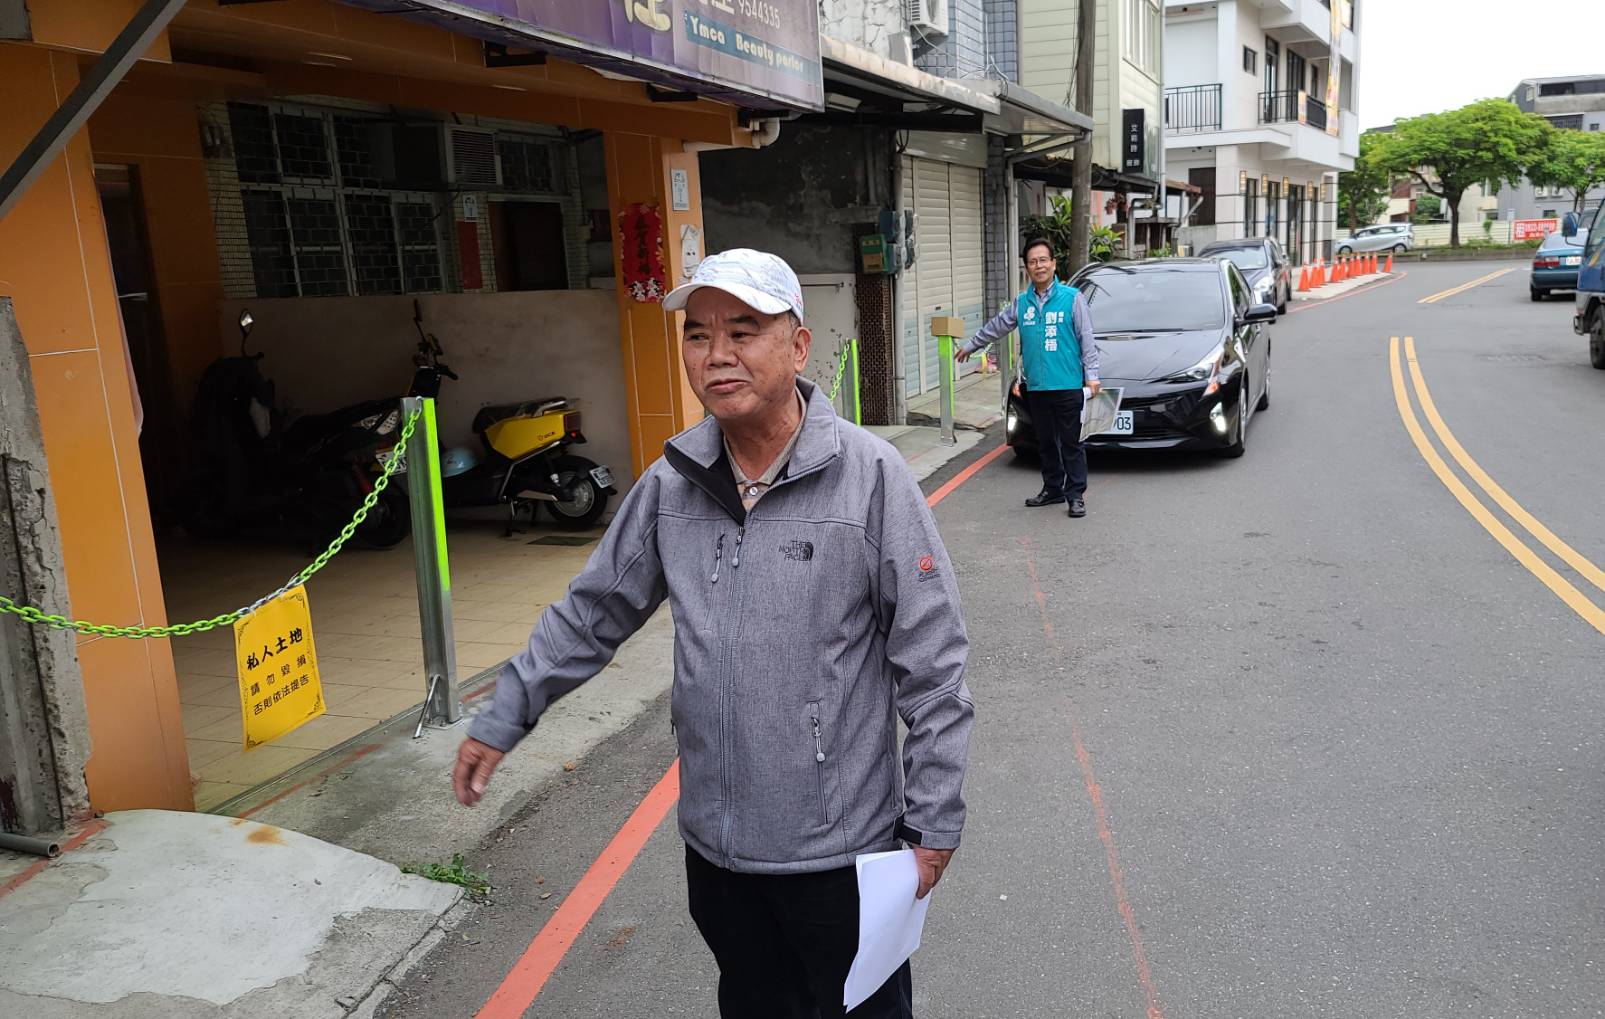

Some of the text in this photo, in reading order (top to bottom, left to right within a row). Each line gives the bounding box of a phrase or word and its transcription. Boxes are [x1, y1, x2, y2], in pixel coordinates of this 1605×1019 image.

[690, 14, 725, 45] Ymca
[736, 33, 774, 67] Beauty
[246, 627, 303, 671] 私人土地
[250, 654, 307, 697] 請勿毀損
[253, 674, 310, 716] 否則依法提告
